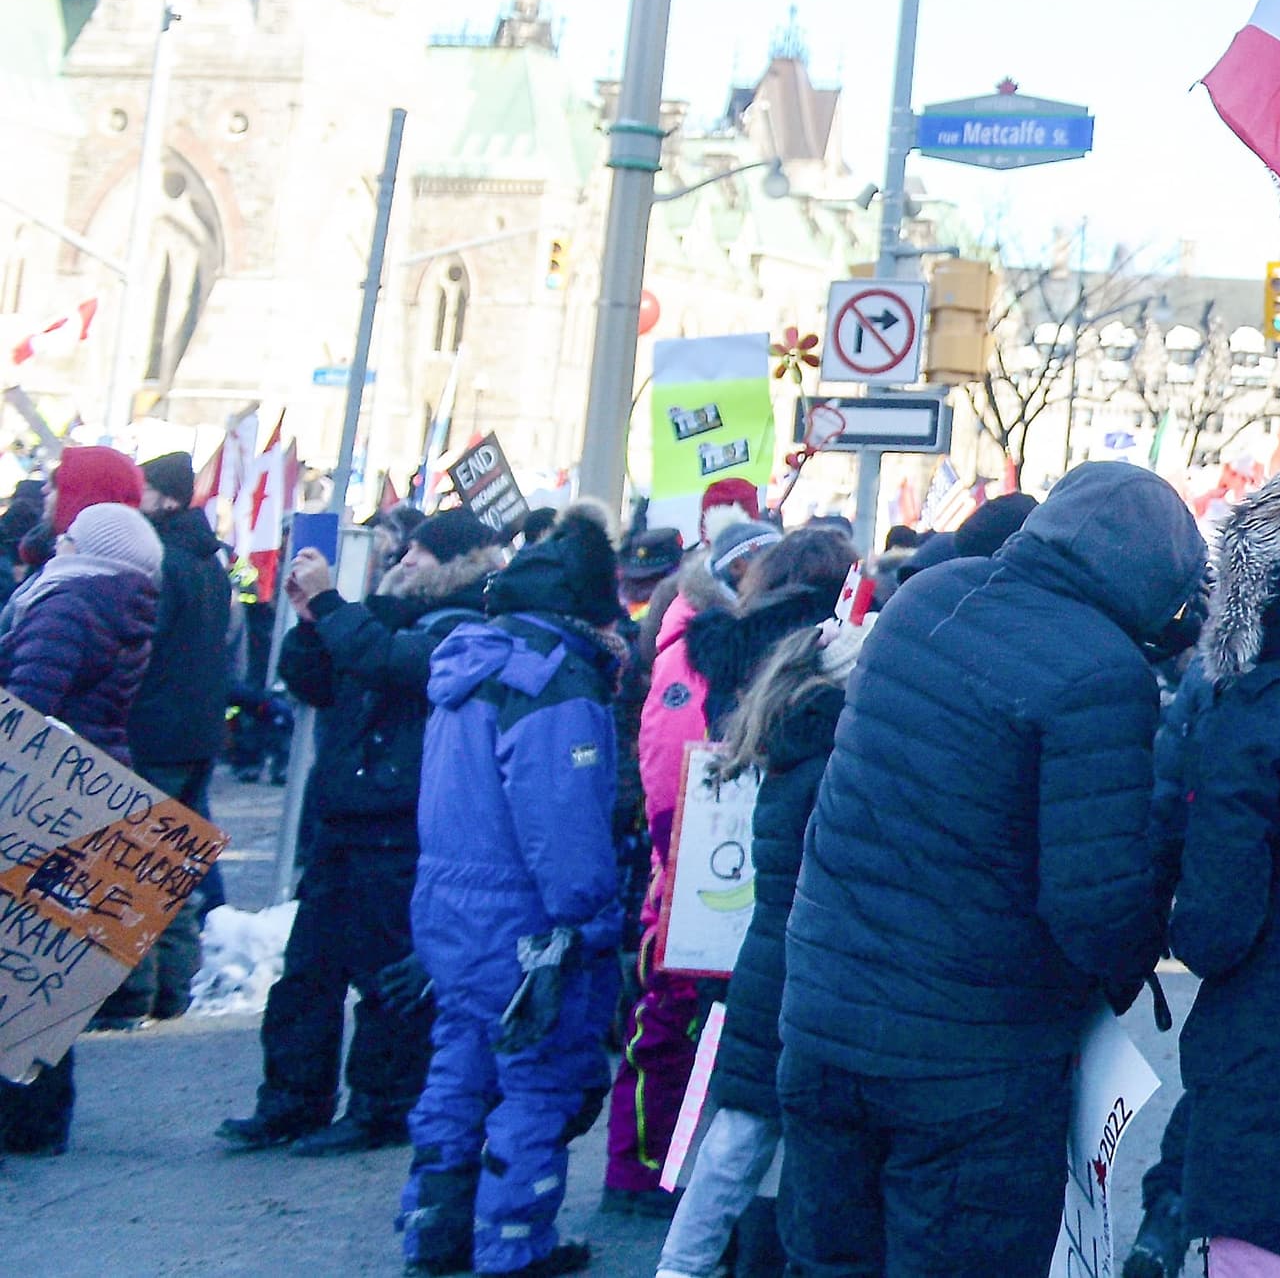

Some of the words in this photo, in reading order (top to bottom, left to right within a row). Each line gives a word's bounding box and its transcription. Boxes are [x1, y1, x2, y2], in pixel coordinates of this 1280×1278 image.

[938, 131, 959, 145] rue
[963, 121, 1045, 145] Metcalfe
[456, 444, 500, 490] END
[21, 726, 51, 760] A
[52, 745, 153, 826] PROUD
[151, 816, 213, 864] SMALL
[1100, 1097, 1133, 1166] 2022
